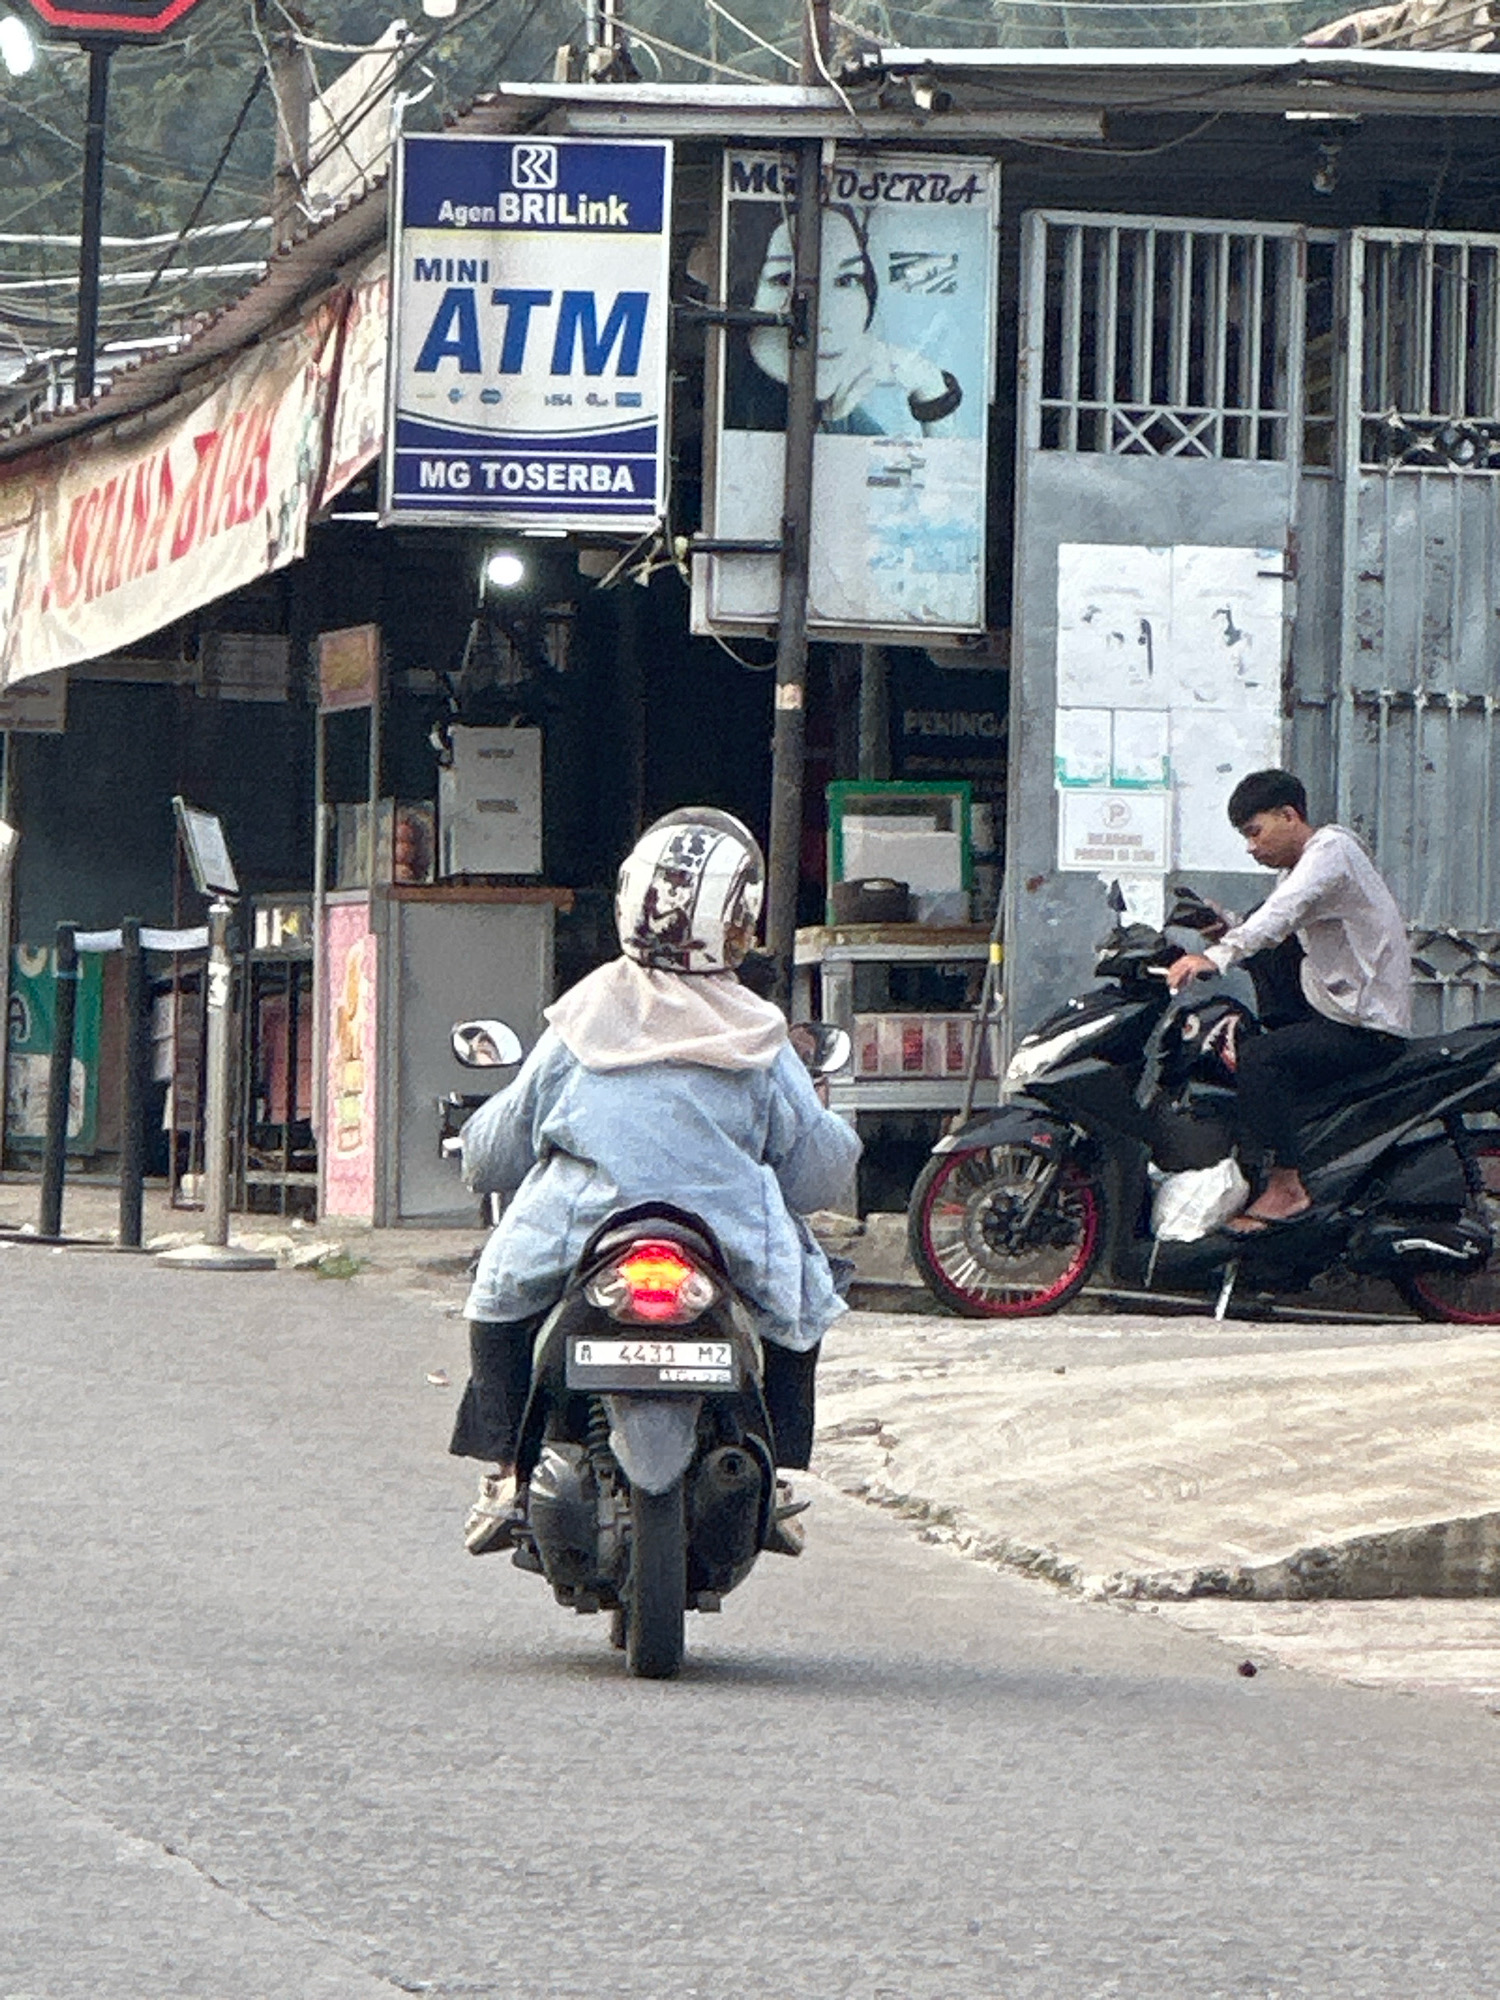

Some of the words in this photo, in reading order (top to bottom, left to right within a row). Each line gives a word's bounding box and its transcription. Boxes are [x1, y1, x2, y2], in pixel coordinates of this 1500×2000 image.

[821, 168, 986, 204] OSERBA
[438, 200, 496, 227] Agen
[498, 192, 630, 227] BRILink
[414, 257, 489, 283] MINI
[414, 286, 651, 377] ATM
[419, 460, 471, 489] MG
[481, 463, 635, 493] TOSERBA
[618, 1344, 676, 1364] 4431
[698, 1345, 727, 1365] MZ
